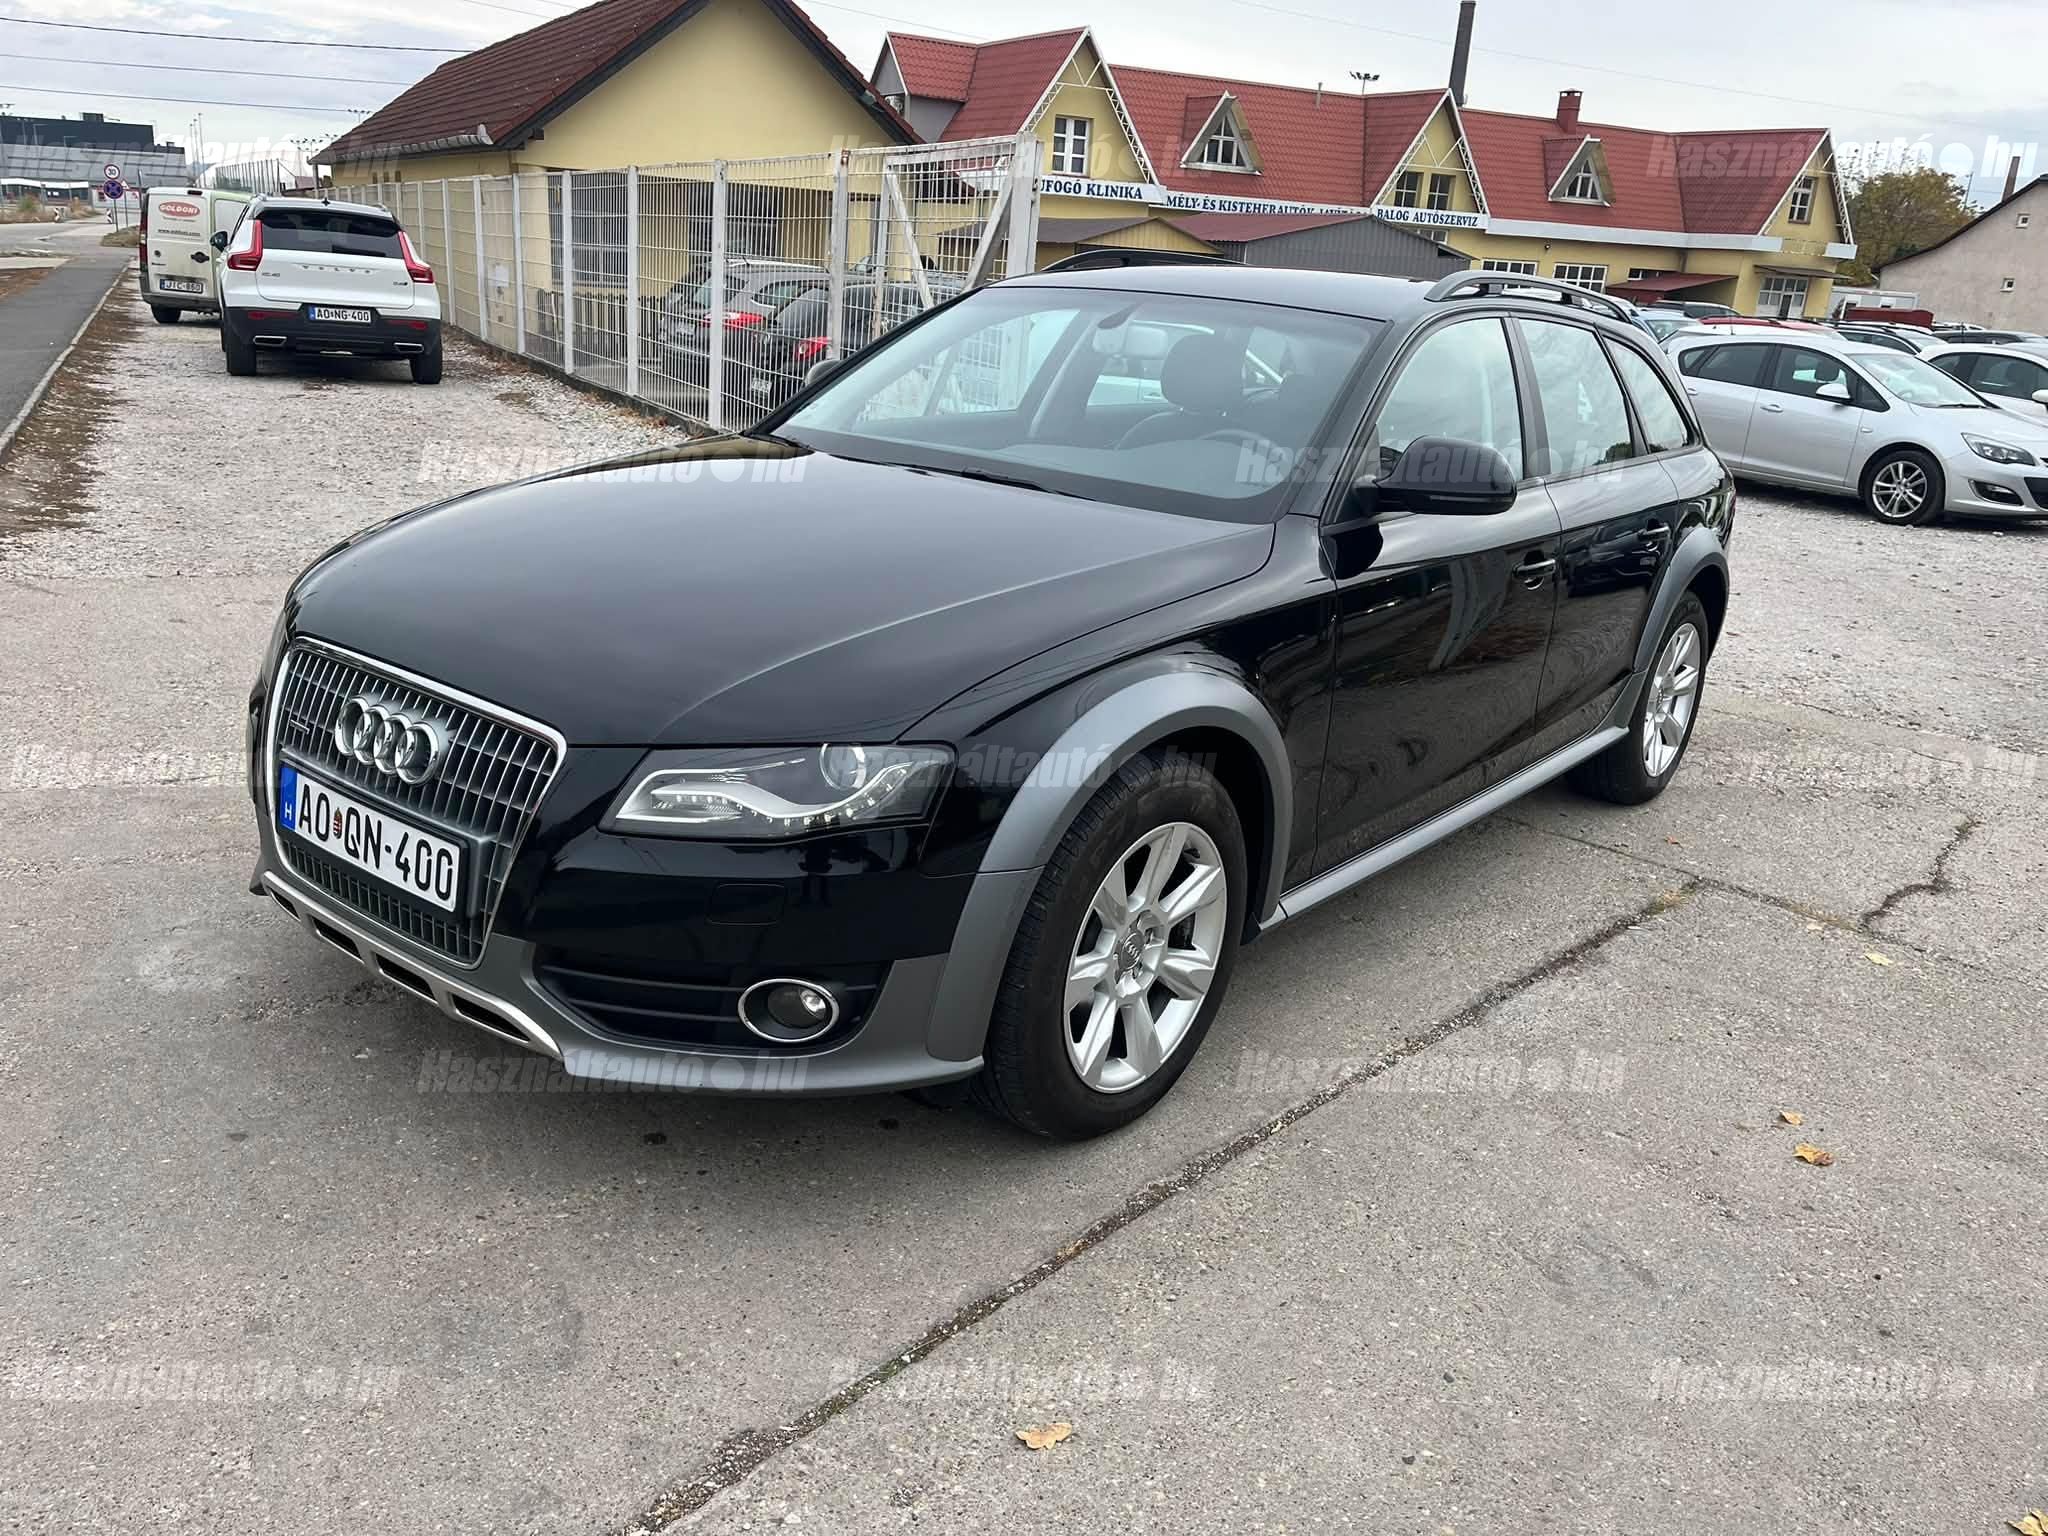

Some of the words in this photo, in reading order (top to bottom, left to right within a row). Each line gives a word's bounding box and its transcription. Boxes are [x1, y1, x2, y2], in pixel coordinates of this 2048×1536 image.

[1086, 183, 1143, 200] KLINIKA
[1202, 196, 1216, 210] ÉS
[1377, 208, 1409, 221] BALOG
[283, 801, 294, 820] H
